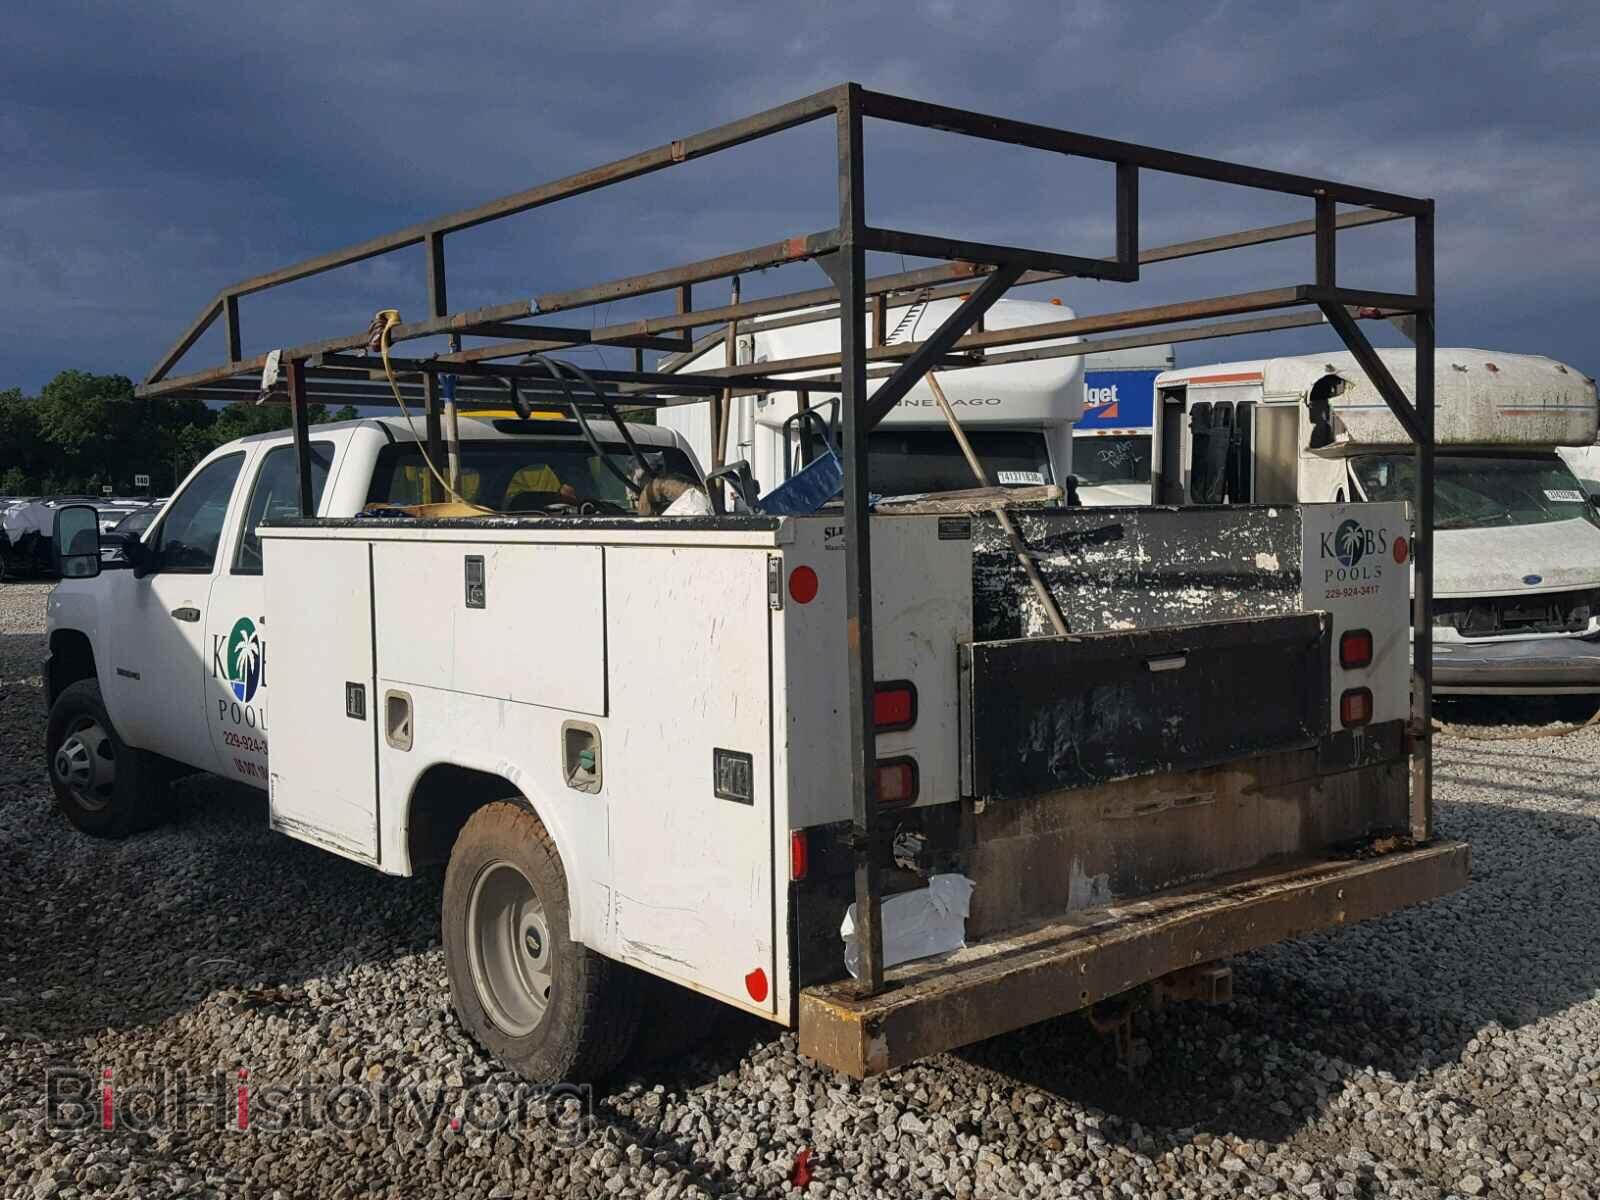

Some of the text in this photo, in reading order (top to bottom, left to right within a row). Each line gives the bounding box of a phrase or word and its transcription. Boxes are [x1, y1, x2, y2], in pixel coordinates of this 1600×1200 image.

[1324, 565, 1382, 583] POOLS
[1325, 584, 1382, 600] 229-924-3417
[219, 700, 267, 730] POOL
[224, 731, 268, 755] 229-924-3
